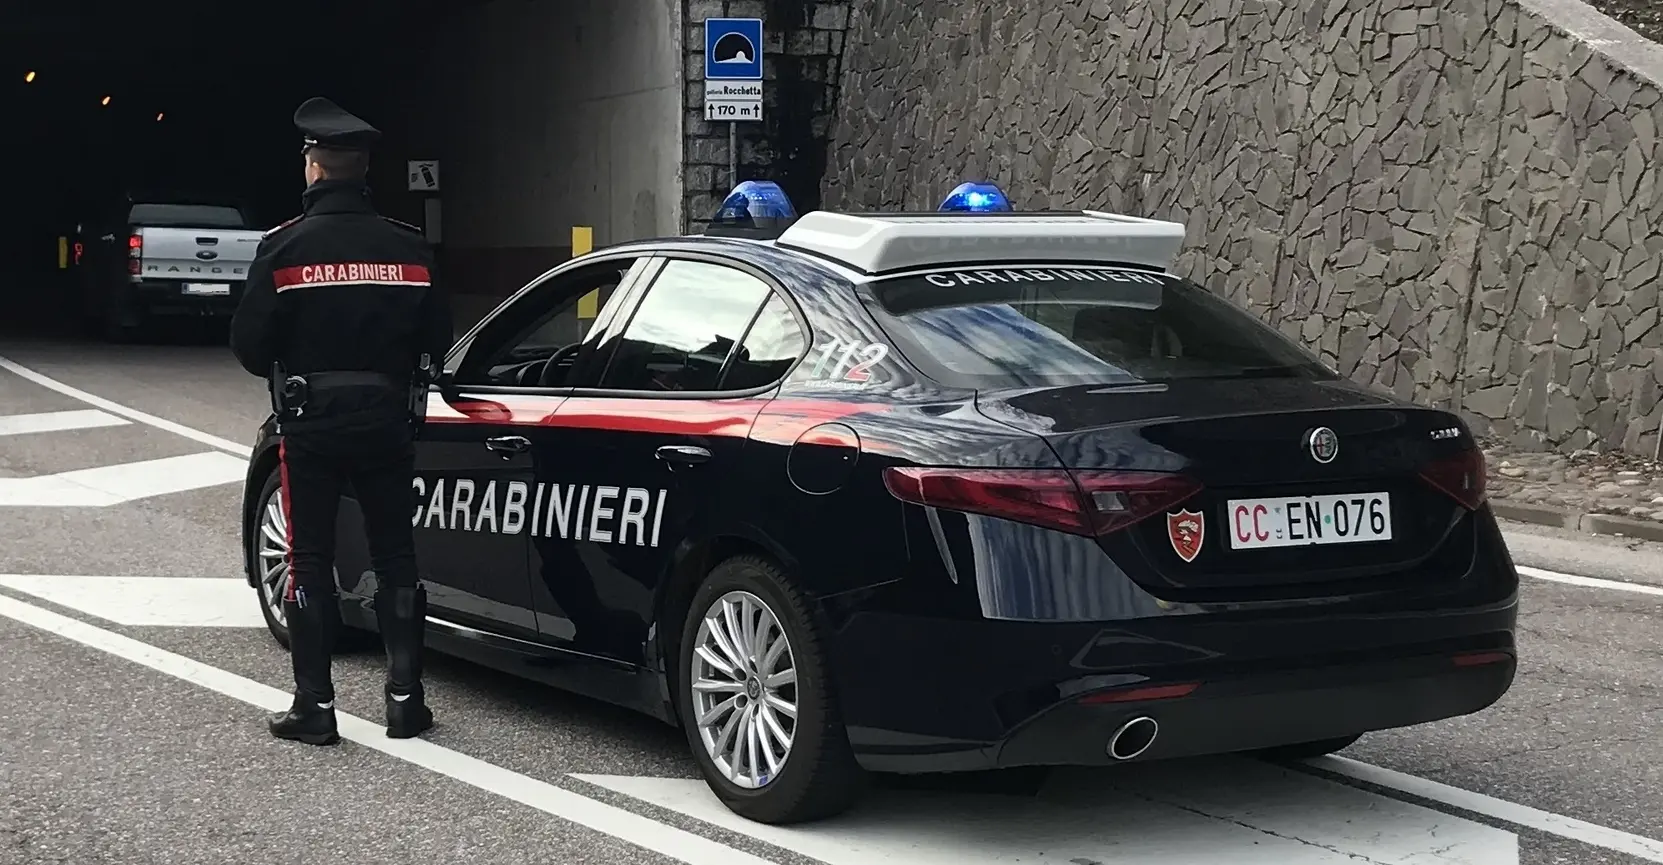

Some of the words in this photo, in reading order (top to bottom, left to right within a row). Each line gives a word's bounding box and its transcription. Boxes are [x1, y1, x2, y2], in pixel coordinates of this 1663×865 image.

[723, 86, 761, 95] Rocchetta
[718, 105, 736, 115] 170
[302, 263, 403, 283] CARABINIERI
[924, 268, 1166, 288] CARABINIERI
[810, 338, 889, 382] 112
[1235, 504, 1270, 543] CC
[1286, 501, 1323, 540] EN
[1333, 498, 1385, 537] 076
